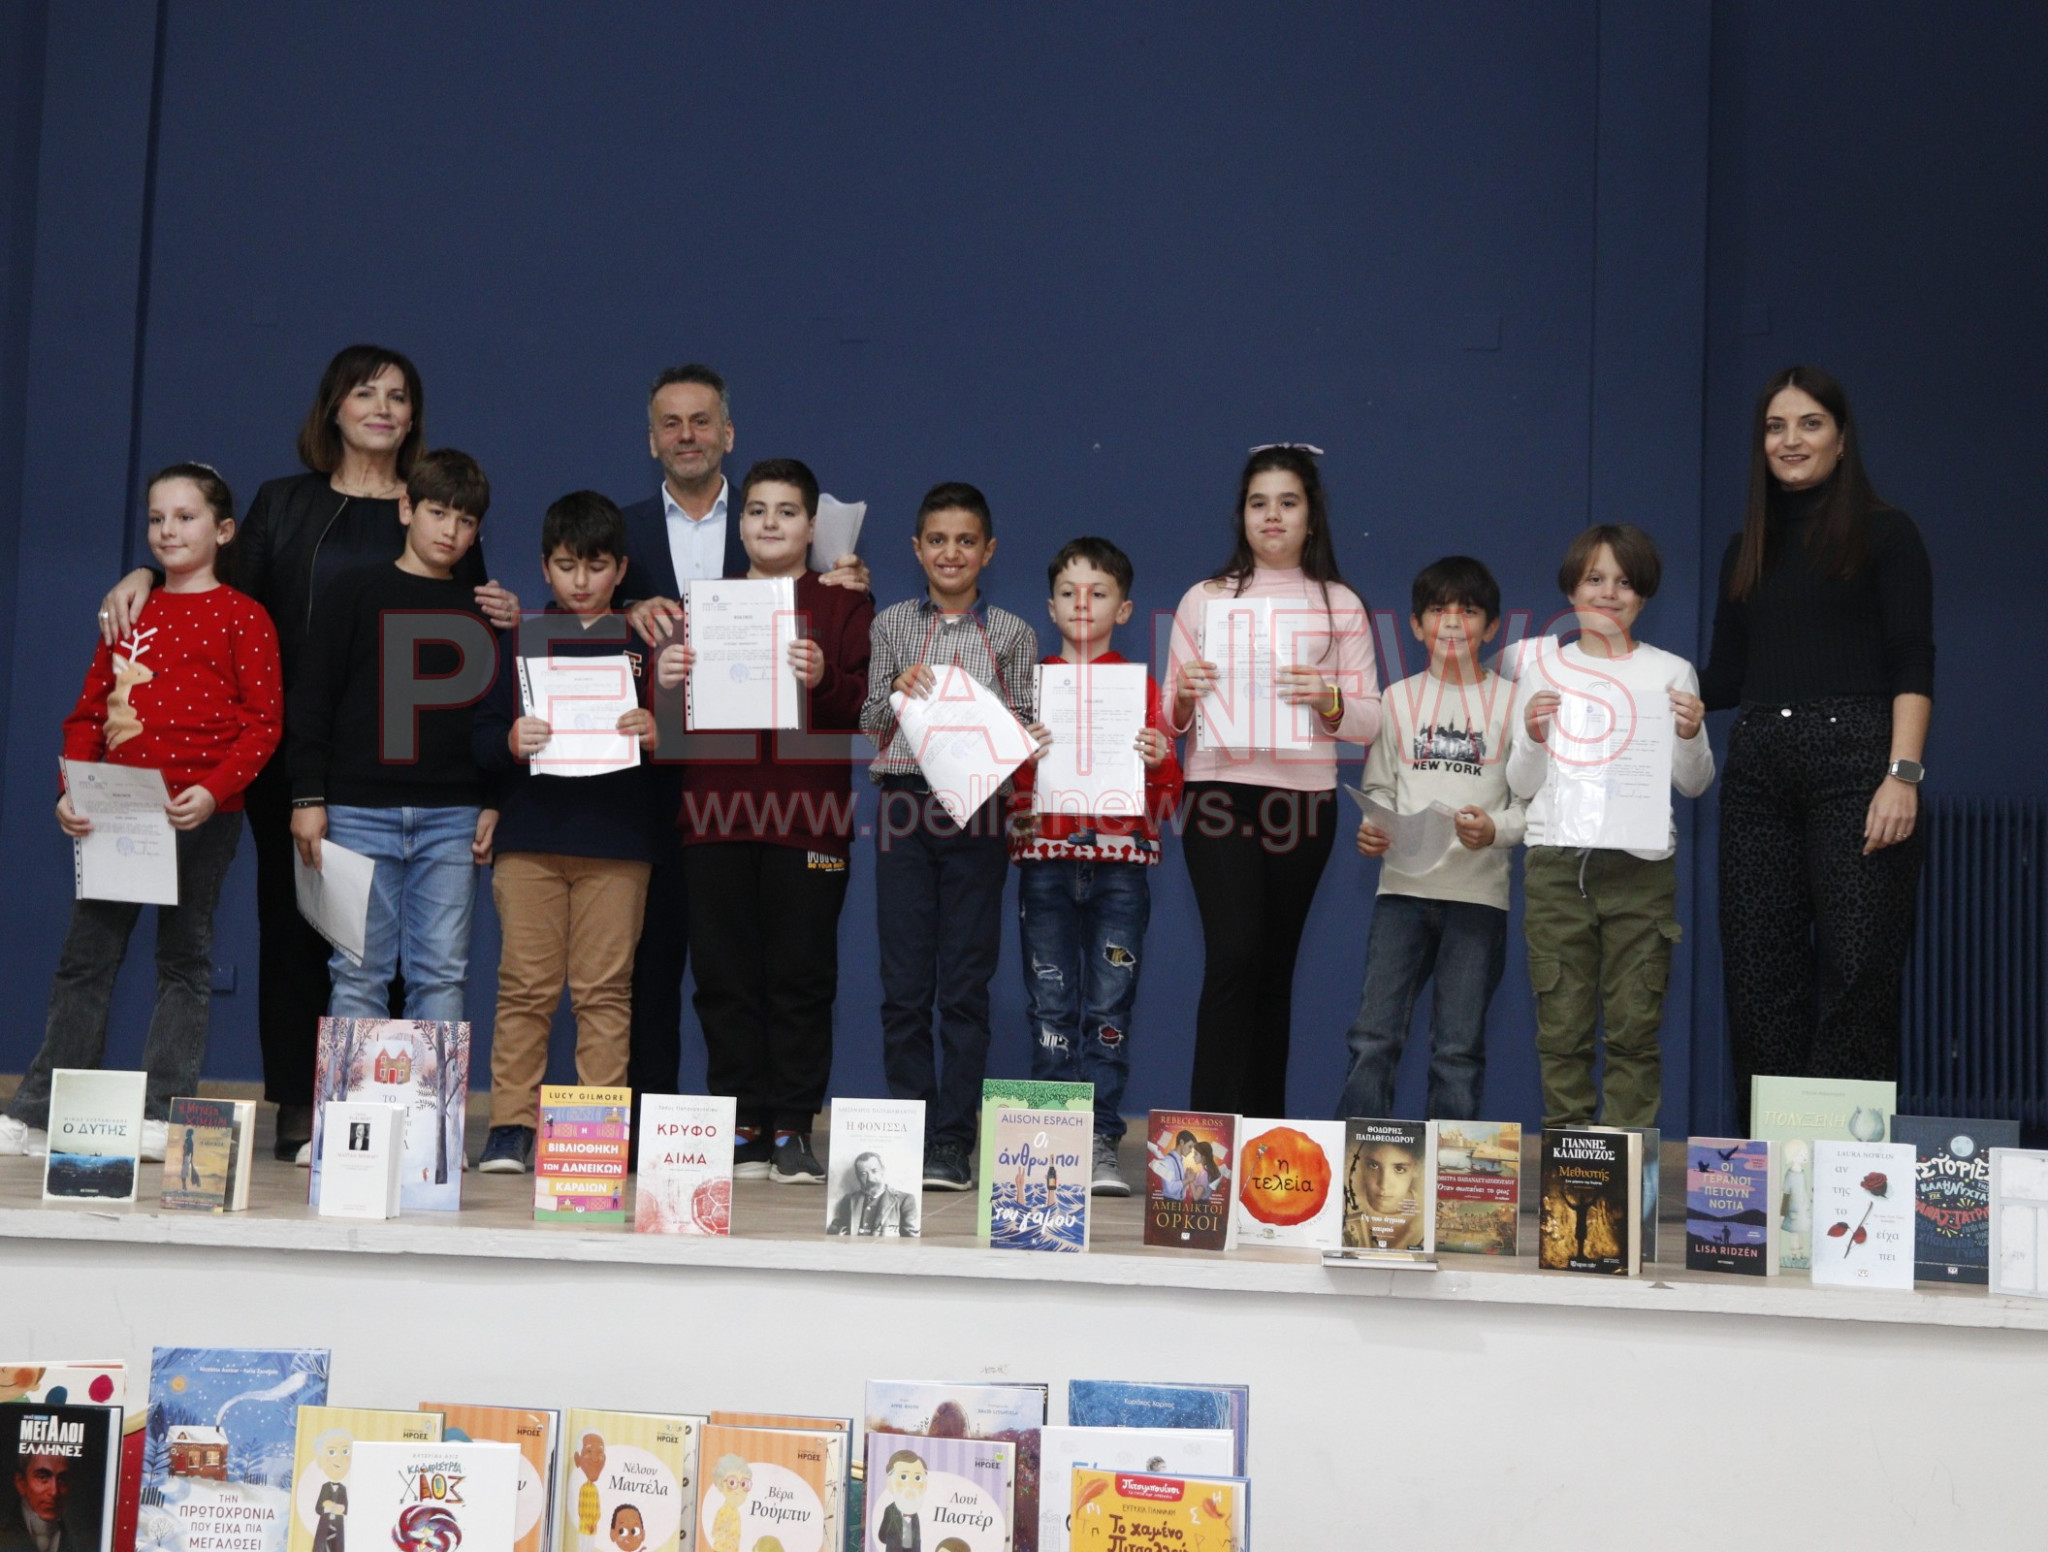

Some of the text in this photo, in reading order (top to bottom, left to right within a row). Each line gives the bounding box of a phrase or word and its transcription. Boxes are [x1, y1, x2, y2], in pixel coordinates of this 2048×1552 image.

[1412, 760, 1483, 776] NEW YORK
[549, 1091, 624, 1101] LUCY GILMORE
[846, 1121, 908, 1132] Η ΦΟΝΙΣΣΑ
[1001, 1114, 1083, 1127] ALISON ESPACH
[1161, 1116, 1224, 1127] REBECCA ROSS
[78, 1123, 127, 1136] ΔΥΤΗΣ
[657, 1123, 717, 1137] ΚΡΥΦΟ
[548, 1142, 619, 1154] ΒΙΒΛΙΟΘΗΚΗ
[1562, 1137, 1607, 1149] ΓΙΑΝΝΗΣ
[663, 1152, 708, 1164] ΑΙΜΑ
[1553, 1147, 1616, 1161] ΚΑΛΠΟΥΖΟΣ
[1837, 1150, 1895, 1160] LAURA NOWLIN
[562, 1162, 622, 1174] ΔΑΝΕΙΚΩΝ
[1278, 1159, 1290, 1174] η
[1721, 1162, 1734, 1172] ΟΙ
[1835, 1166, 1849, 1174] αν
[1558, 1165, 1610, 1181] Μεθυστής
[1252, 1174, 1314, 1192] τελεία
[1704, 1174, 1751, 1186] ΓΕΡΑΝΟΙ
[556, 1183, 607, 1193] ΚΑΡΔΙΩΝ
[1705, 1186, 1750, 1198] ΠΕΤΟΥΝ
[1709, 1199, 1745, 1211] ΝΟΤΙΑ
[1835, 1208, 1848, 1216] το
[1156, 1212, 1219, 1231] ΟΡΚΟΙ
[1695, 1244, 1717, 1254] LISA
[20, 1415, 85, 1443] ΜΕΓΑΛΟΙ
[517, 1429, 541, 1437] ΗΡΩΕΣ
[403, 1432, 428, 1440] ΗΡΩΕΣ
[656, 1436, 679, 1444] ΗΡΩΕΣ
[18, 1442, 83, 1457] ΕΛΛΗΝΕΣ
[797, 1453, 821, 1461] ΗΡΩΕΣ
[623, 1462, 658, 1476] Νέλσον
[974, 1461, 1001, 1469] ΗΡΩΕΣ
[608, 1474, 669, 1497] Μαντέλα
[219, 1494, 239, 1503] ΤΗΝ
[768, 1486, 795, 1502] Βέρα
[949, 1491, 979, 1505] Λουί
[179, 1505, 275, 1520] ΠΡΩΤΟΧΡΟΝΙΑ
[749, 1500, 811, 1525] Ρούμπιν
[933, 1506, 994, 1533] Παστέρ
[191, 1521, 262, 1534] ΠΟΥ ΕΙΧΑ ΠΙΑ
[1109, 1513, 1184, 1542] Το χαμένο
[189, 1537, 262, 1551] ΜΕΓΑΛΩΣΕΙ
